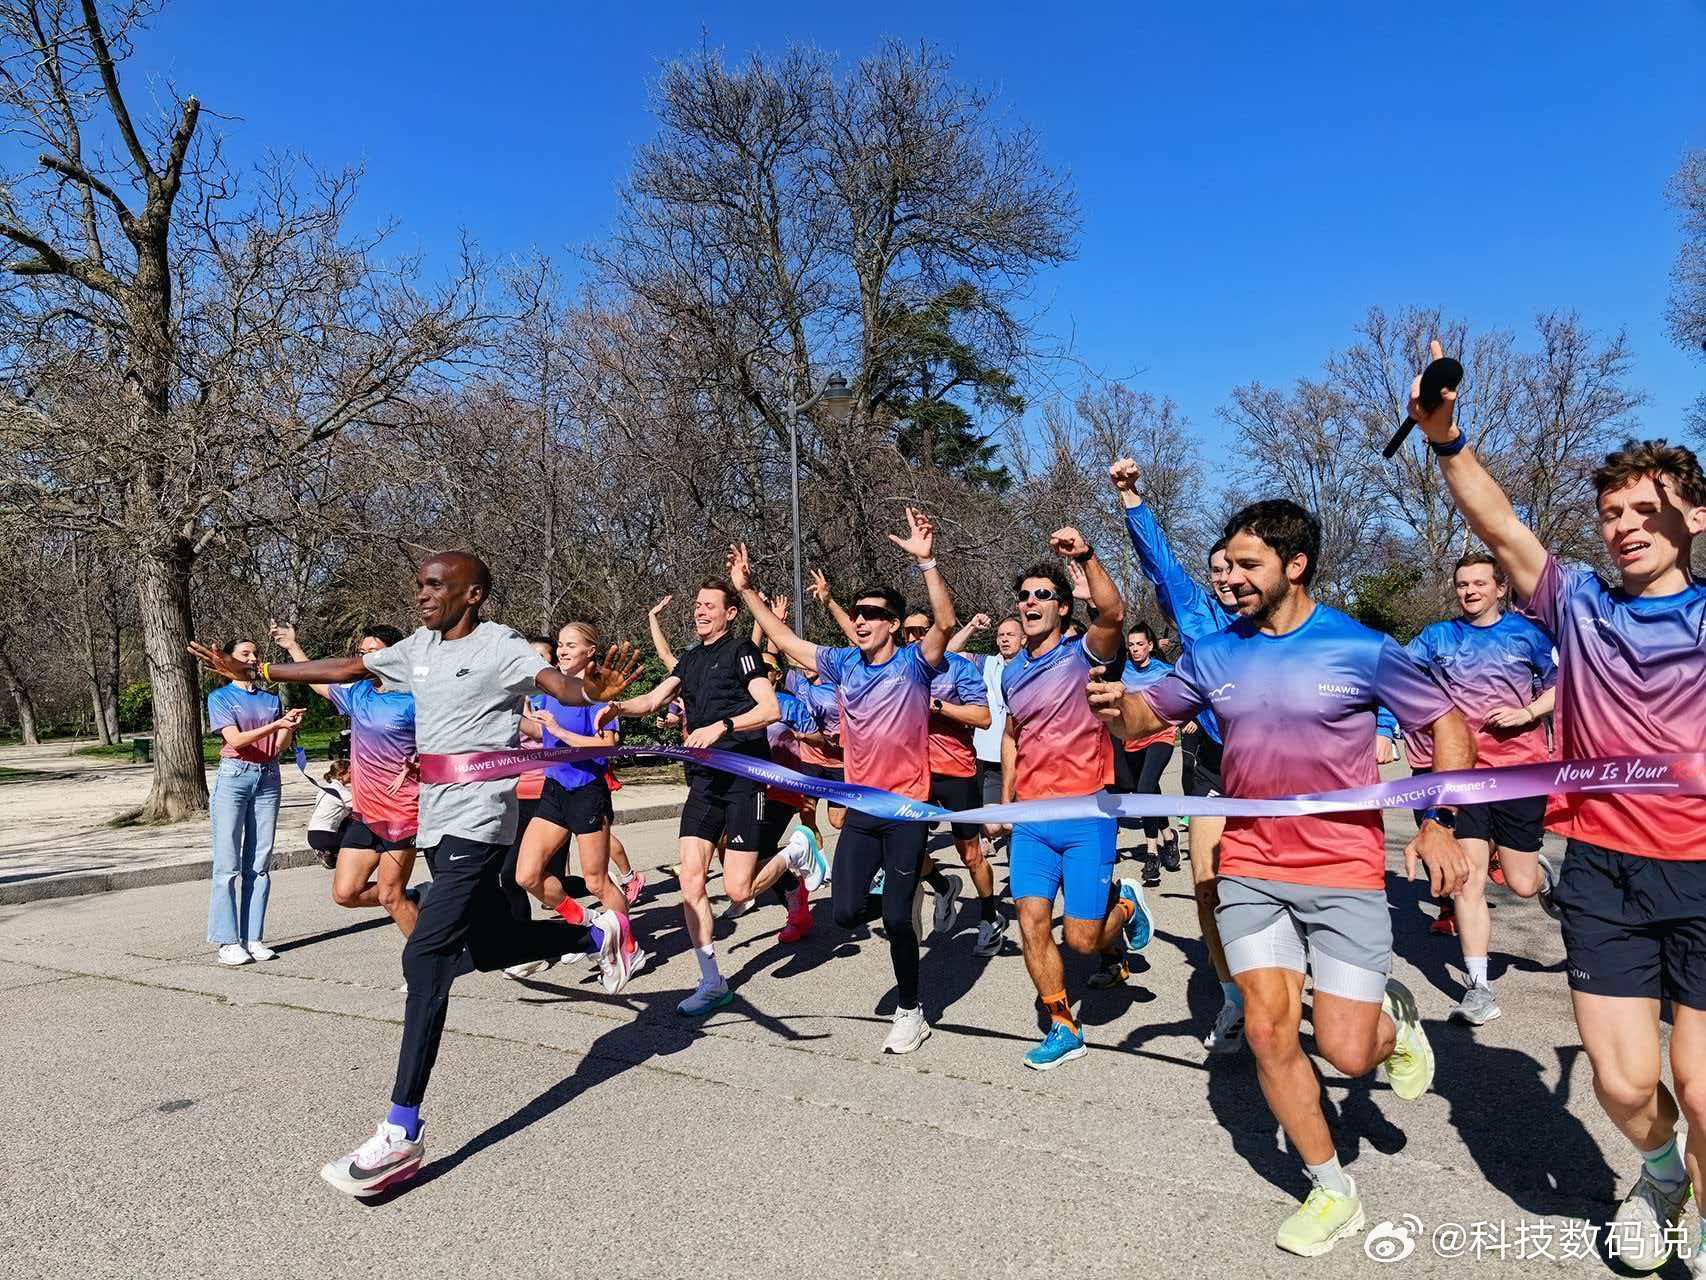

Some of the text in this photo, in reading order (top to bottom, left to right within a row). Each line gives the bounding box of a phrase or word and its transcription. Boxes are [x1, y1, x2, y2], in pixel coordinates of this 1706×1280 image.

[1319, 683, 1360, 695] HUAWEI
[454, 760, 495, 773] HUAWEI
[1554, 764, 1595, 785] Now
[1599, 762, 1619, 780] Is
[1624, 759, 1668, 783] Your
[748, 766, 784, 783] HUAWEI
[786, 779, 815, 792] WATCH
[1384, 789, 1426, 807] WATCH
[1427, 784, 1443, 797] GT
[1445, 780, 1486, 793] Runner
[1489, 777, 1497, 789] 2
[894, 803, 923, 819] Now
